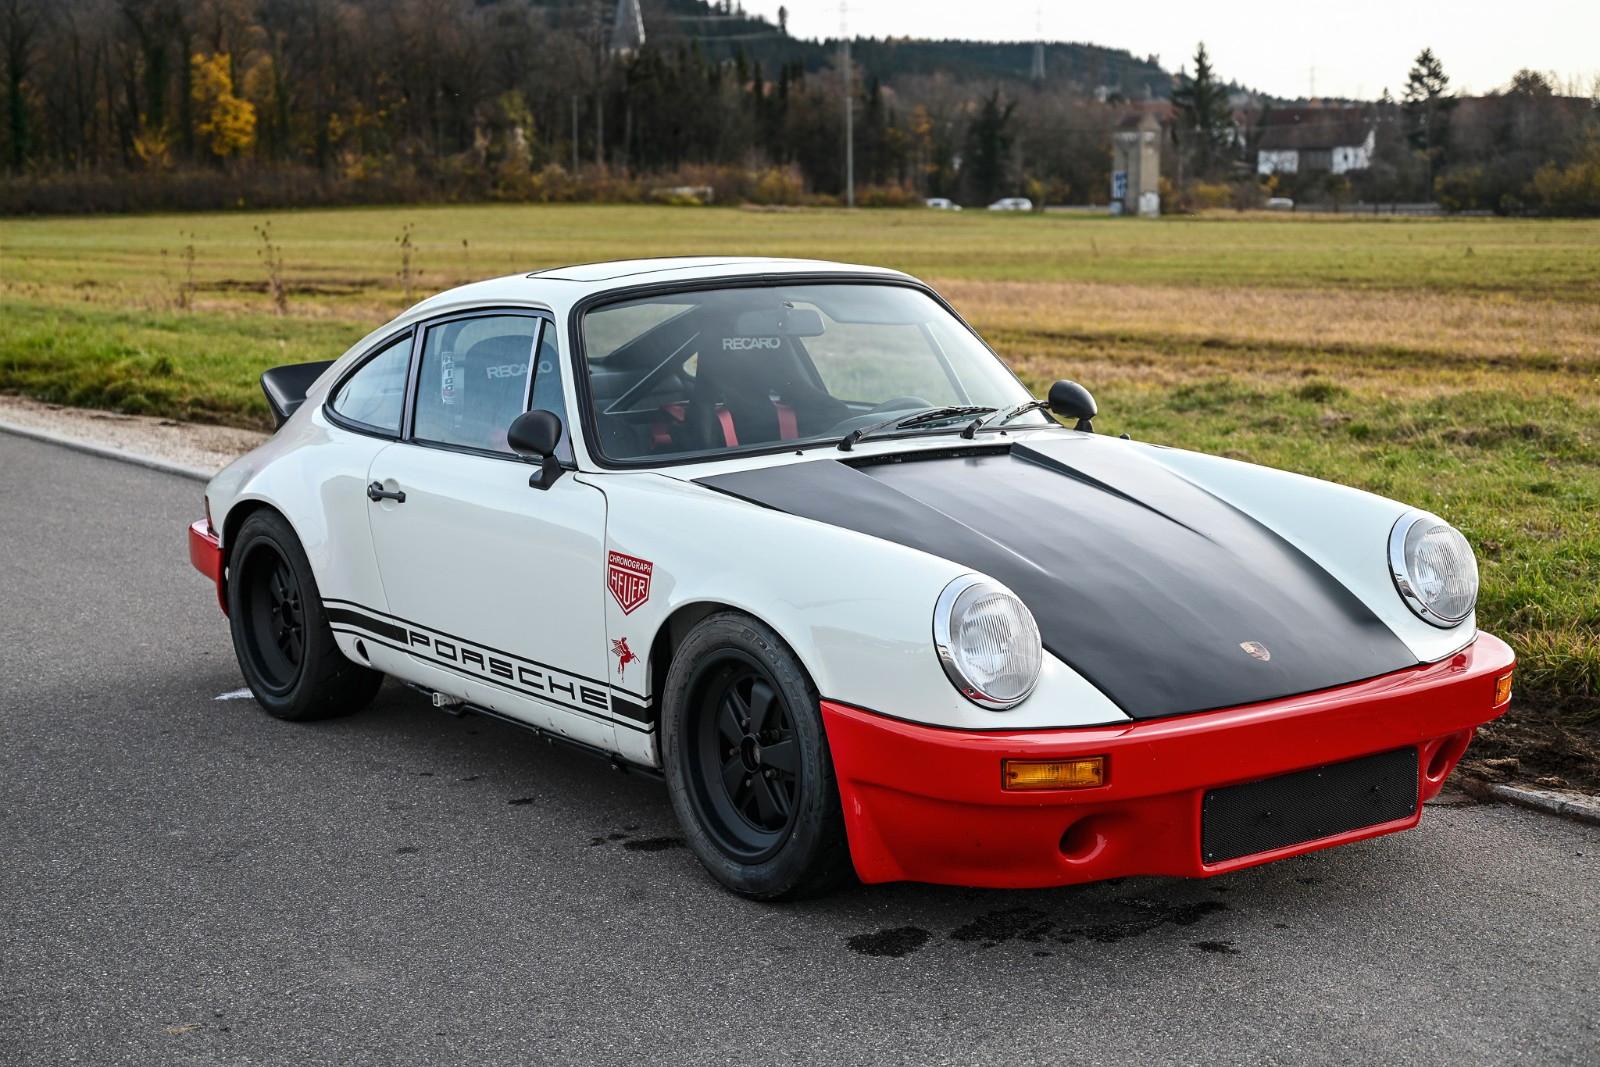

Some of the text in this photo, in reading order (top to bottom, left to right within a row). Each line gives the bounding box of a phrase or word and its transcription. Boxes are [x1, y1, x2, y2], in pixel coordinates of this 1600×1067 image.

[722, 337, 781, 350] RECARO
[486, 361, 553, 380] RECAO
[609, 554, 652, 573] CHRONOGRAPH
[611, 570, 646, 606] HEUER
[409, 630, 609, 710] PORSCHE
